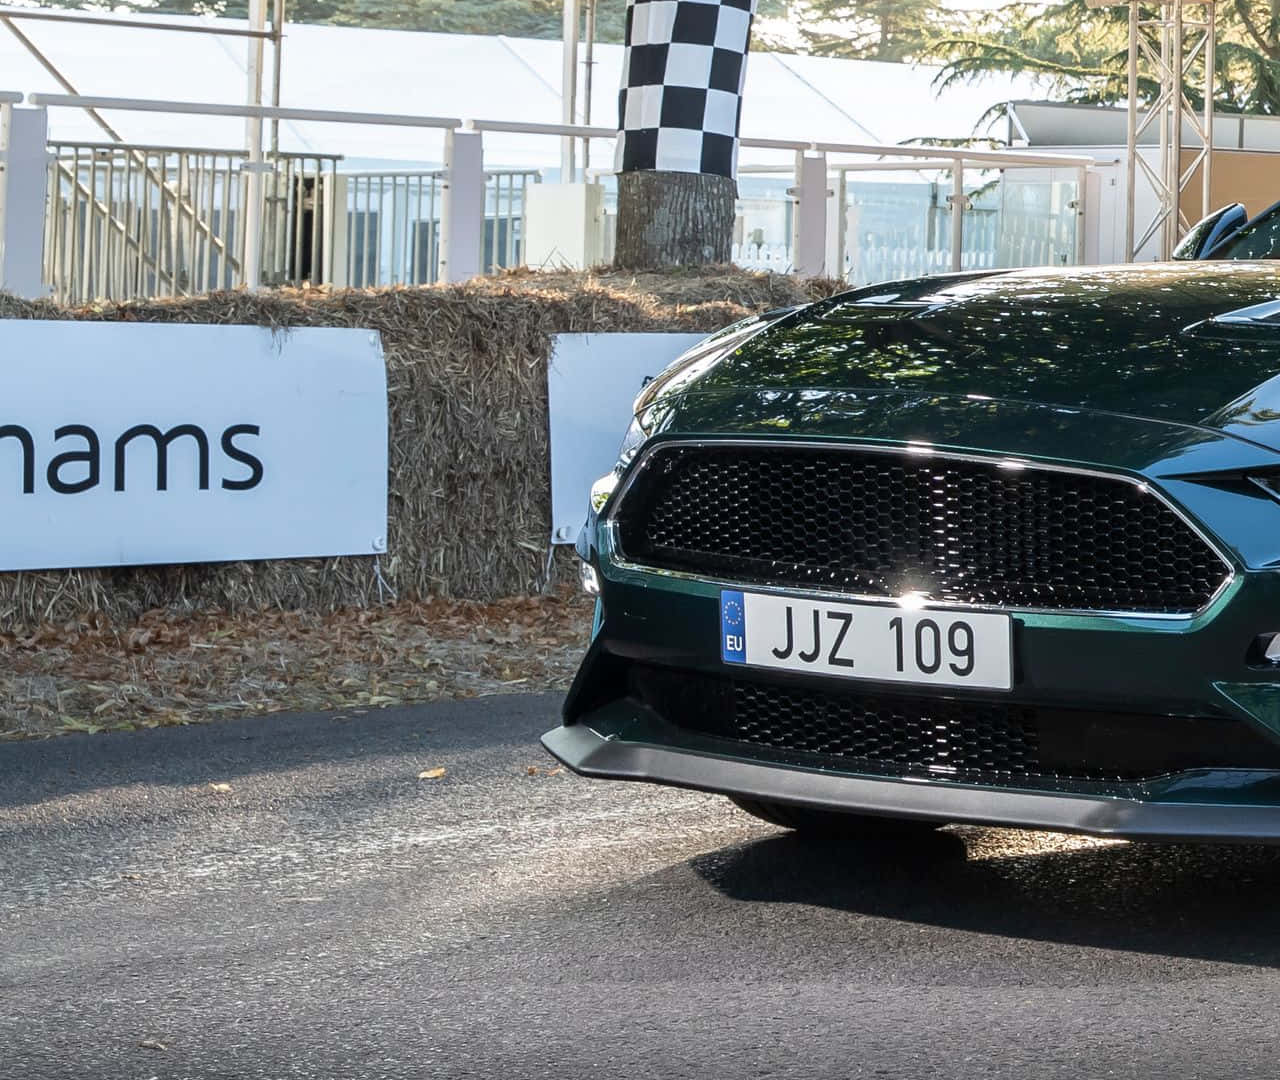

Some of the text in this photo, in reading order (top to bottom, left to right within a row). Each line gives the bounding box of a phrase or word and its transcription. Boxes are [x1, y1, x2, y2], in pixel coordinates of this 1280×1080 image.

[726, 635, 743, 652] EU
[772, 606, 975, 677] JJZ 109
